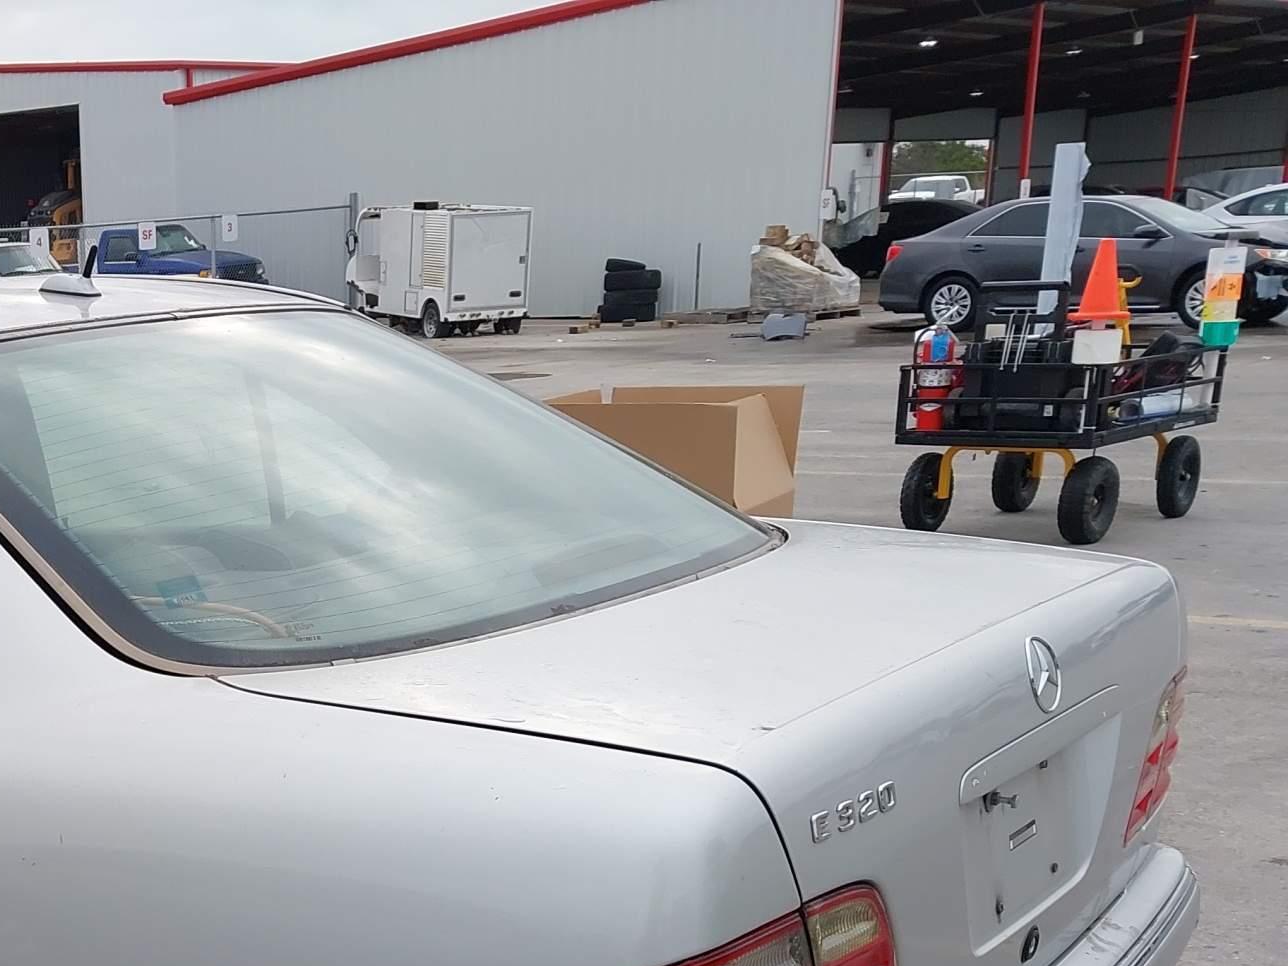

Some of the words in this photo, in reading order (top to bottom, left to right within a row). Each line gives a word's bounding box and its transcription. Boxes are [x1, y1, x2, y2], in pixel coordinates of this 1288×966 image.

[227, 222, 233, 233] 3
[142, 229, 153, 241] SF
[36, 237, 42, 247] 4
[810, 810, 832, 844] E
[836, 779, 897, 832] 320
